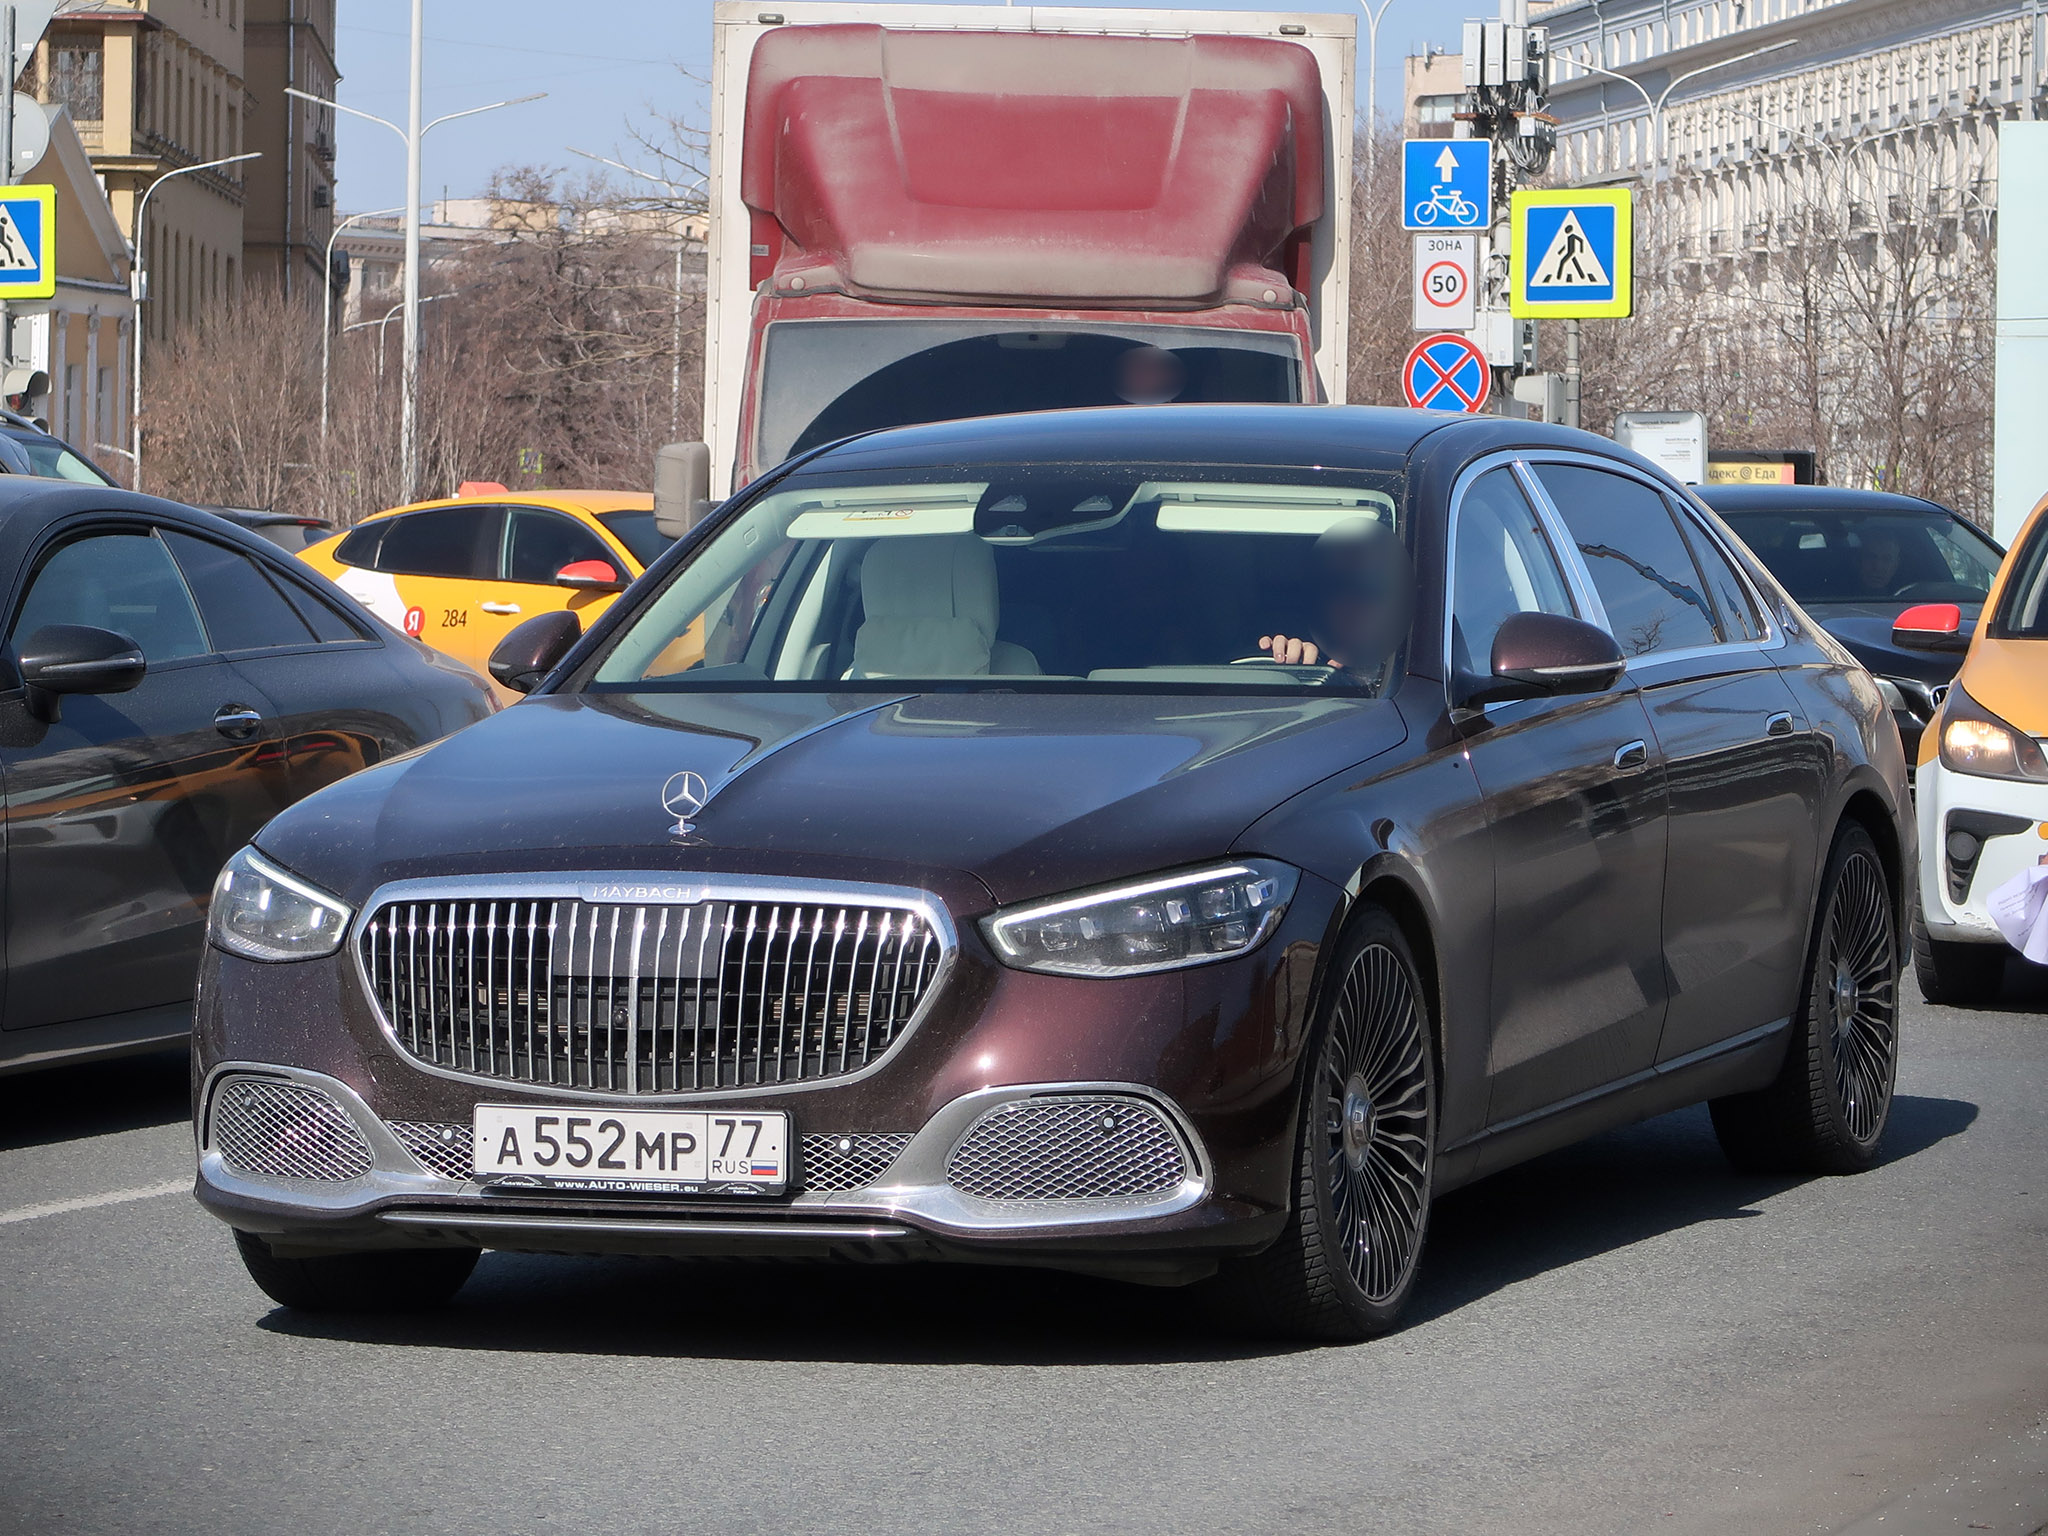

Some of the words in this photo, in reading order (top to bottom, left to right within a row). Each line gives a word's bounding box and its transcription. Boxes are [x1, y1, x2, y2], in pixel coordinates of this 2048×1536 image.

[1428, 240, 1462, 251] ЗОНА
[1432, 275, 1457, 293] 50
[1755, 467, 1776, 480] Еда
[441, 609, 468, 627] 284
[592, 885, 691, 899] MAYBACH
[714, 1119, 763, 1159] 77
[712, 1159, 748, 1176] RUS
[554, 1180, 699, 1194] www.AUTO-WIESER.eu
